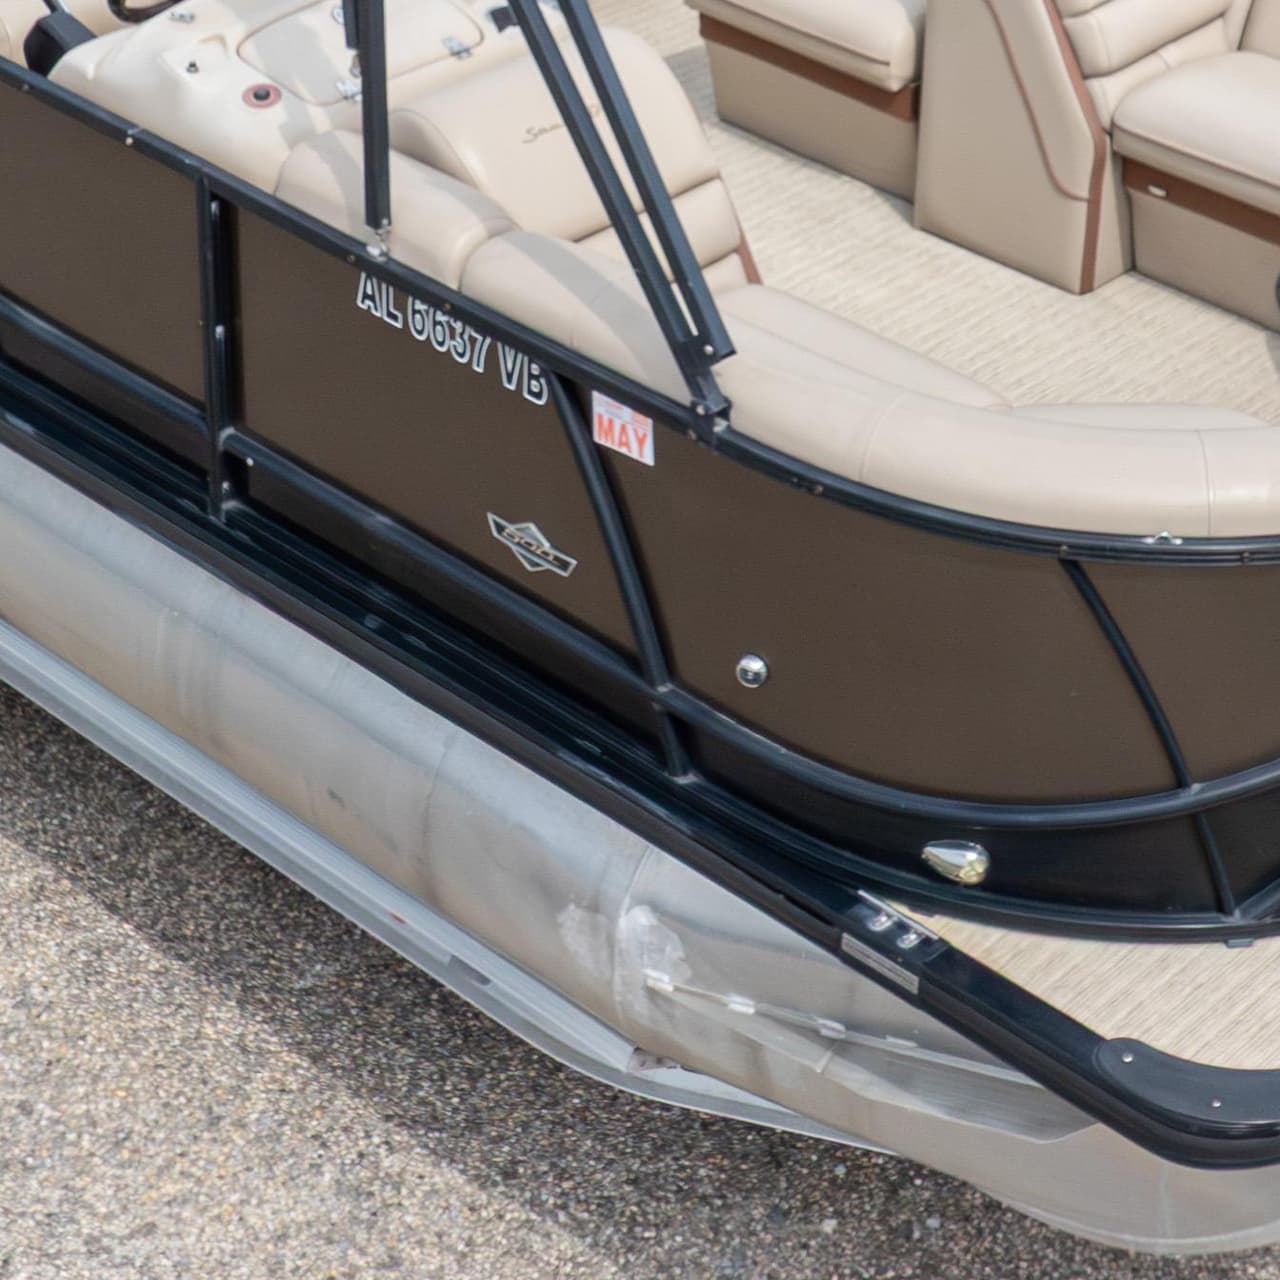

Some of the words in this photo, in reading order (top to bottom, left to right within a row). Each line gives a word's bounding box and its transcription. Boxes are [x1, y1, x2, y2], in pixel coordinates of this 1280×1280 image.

[356, 272, 403, 328] AL
[408, 295, 491, 373] 6637
[497, 340, 548, 406] VB
[596, 412, 648, 458] MAY
